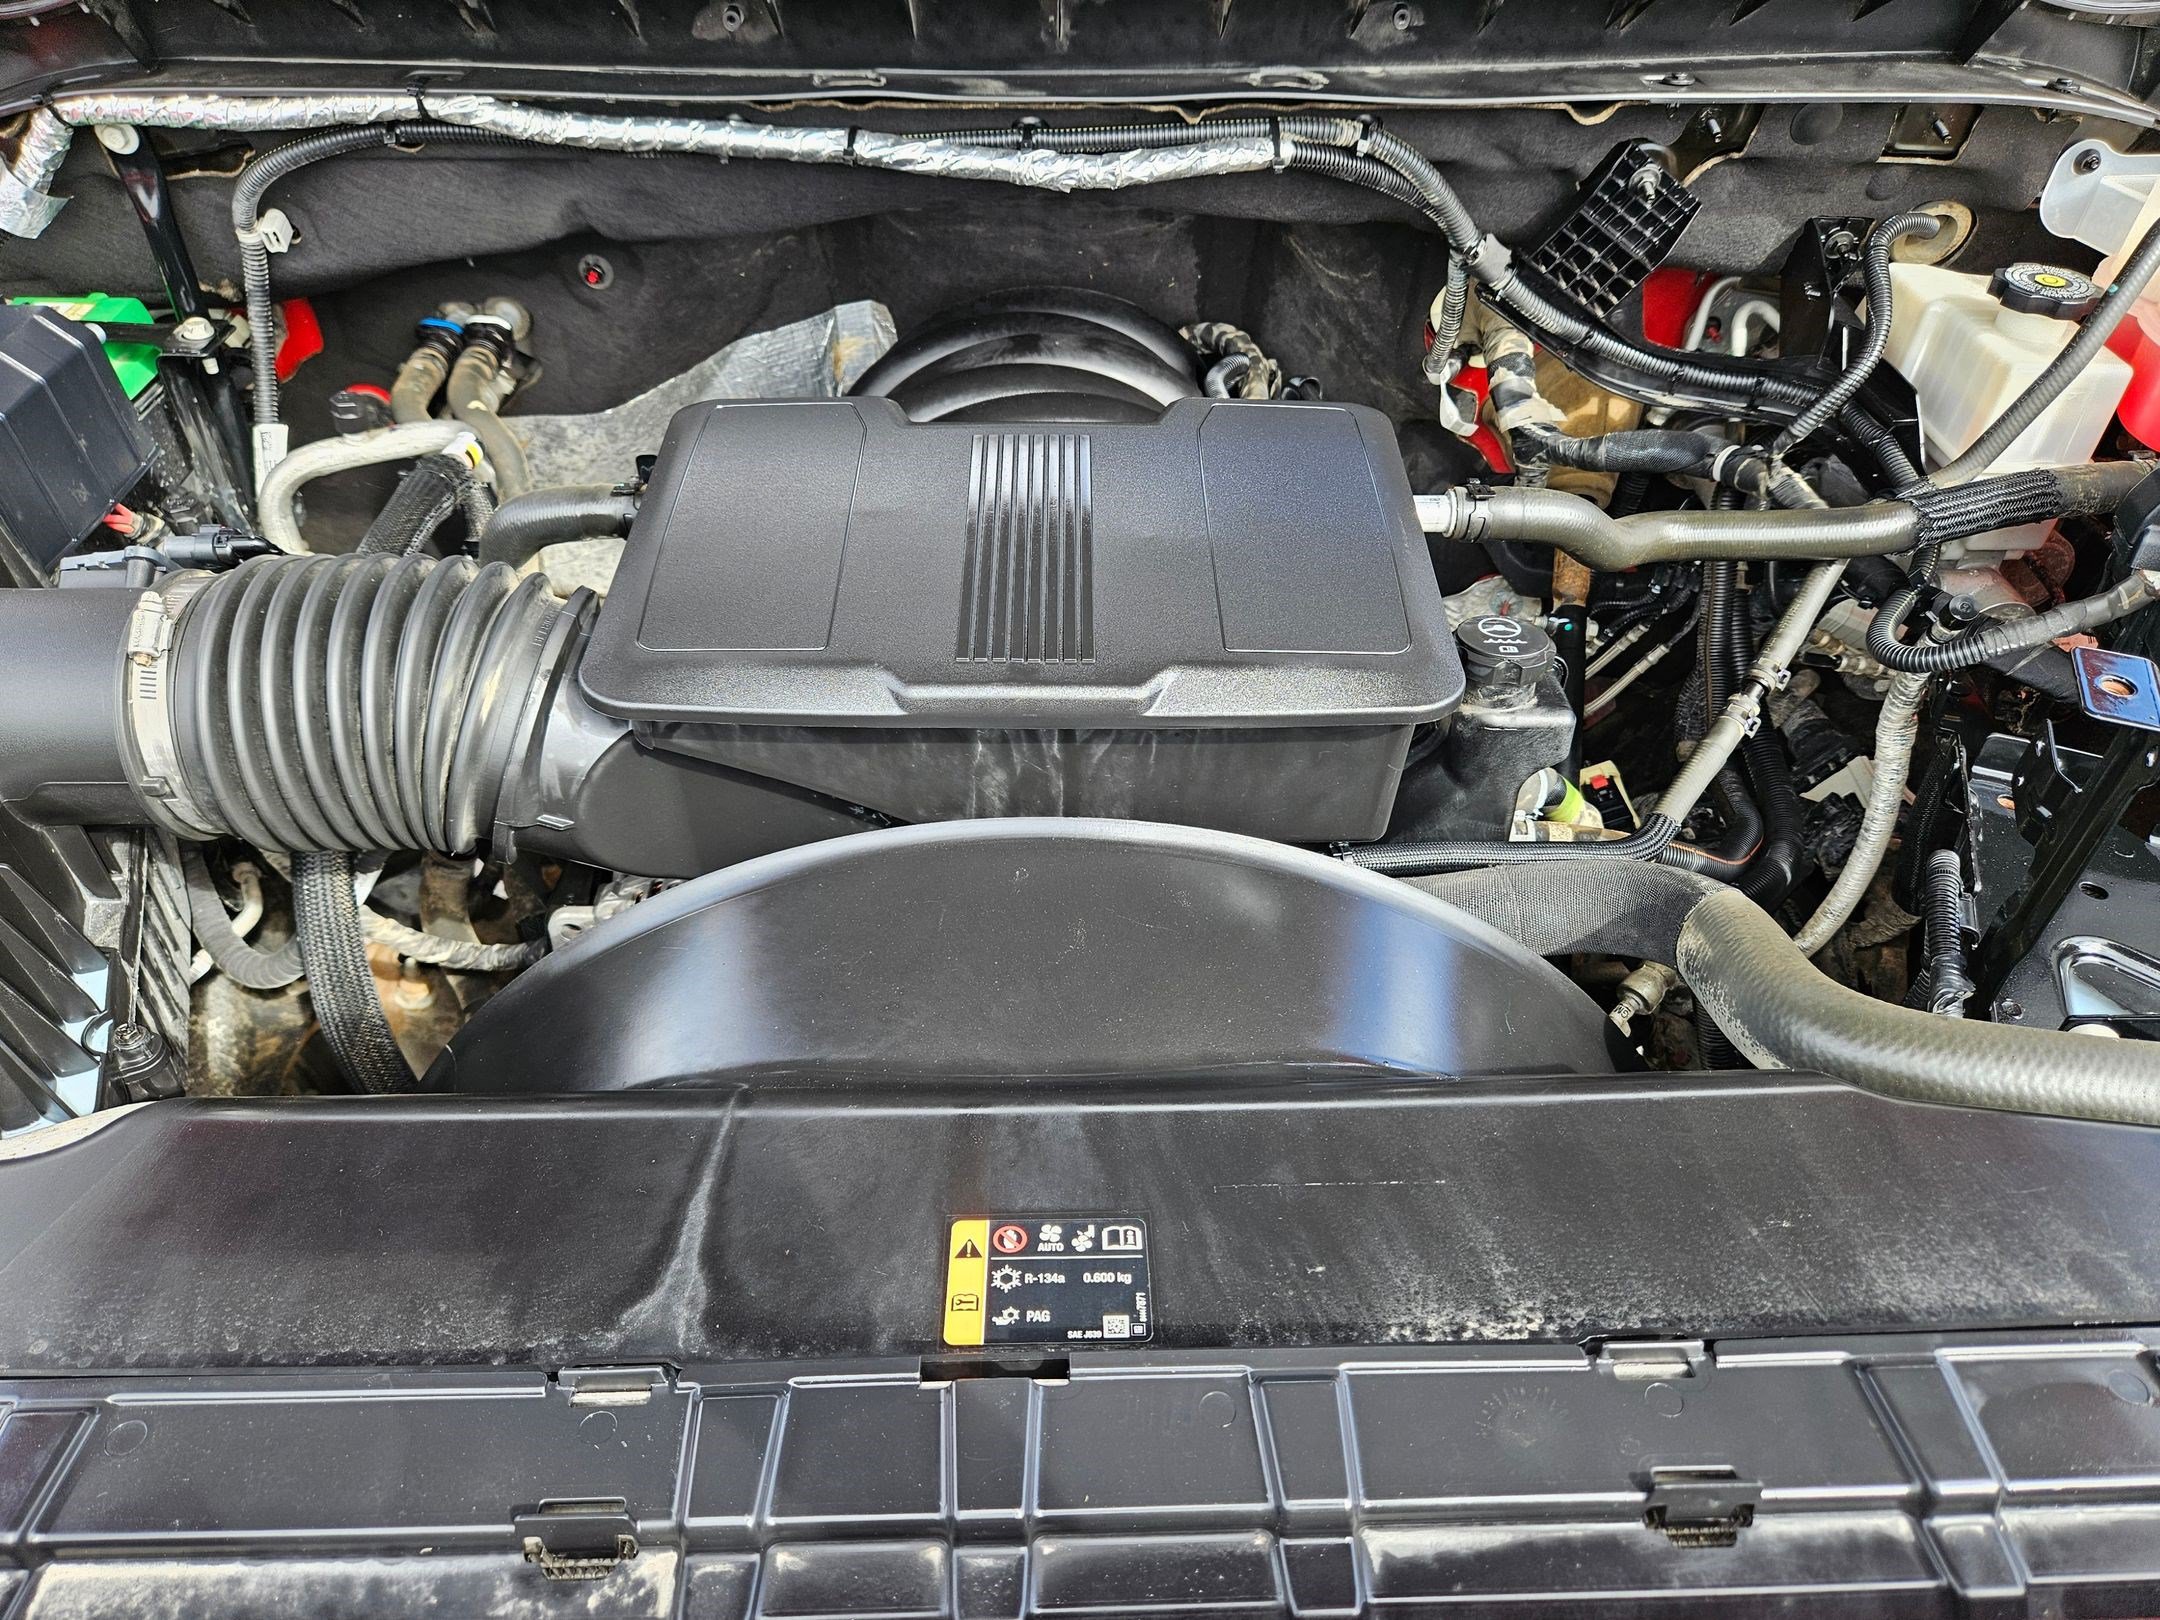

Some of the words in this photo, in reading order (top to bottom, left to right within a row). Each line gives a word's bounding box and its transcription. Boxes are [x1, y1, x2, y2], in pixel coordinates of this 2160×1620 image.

[1613, 1005, 1629, 1018] GM
[1037, 1242, 1064, 1252] AUTO
[1024, 1273, 1066, 1284] R-134a
[1083, 1272, 1115, 1283] 0.600
[1117, 1271, 1132, 1285] kg
[1026, 1310, 1051, 1323] PAG
[1067, 1330, 1083, 1339] SAE
